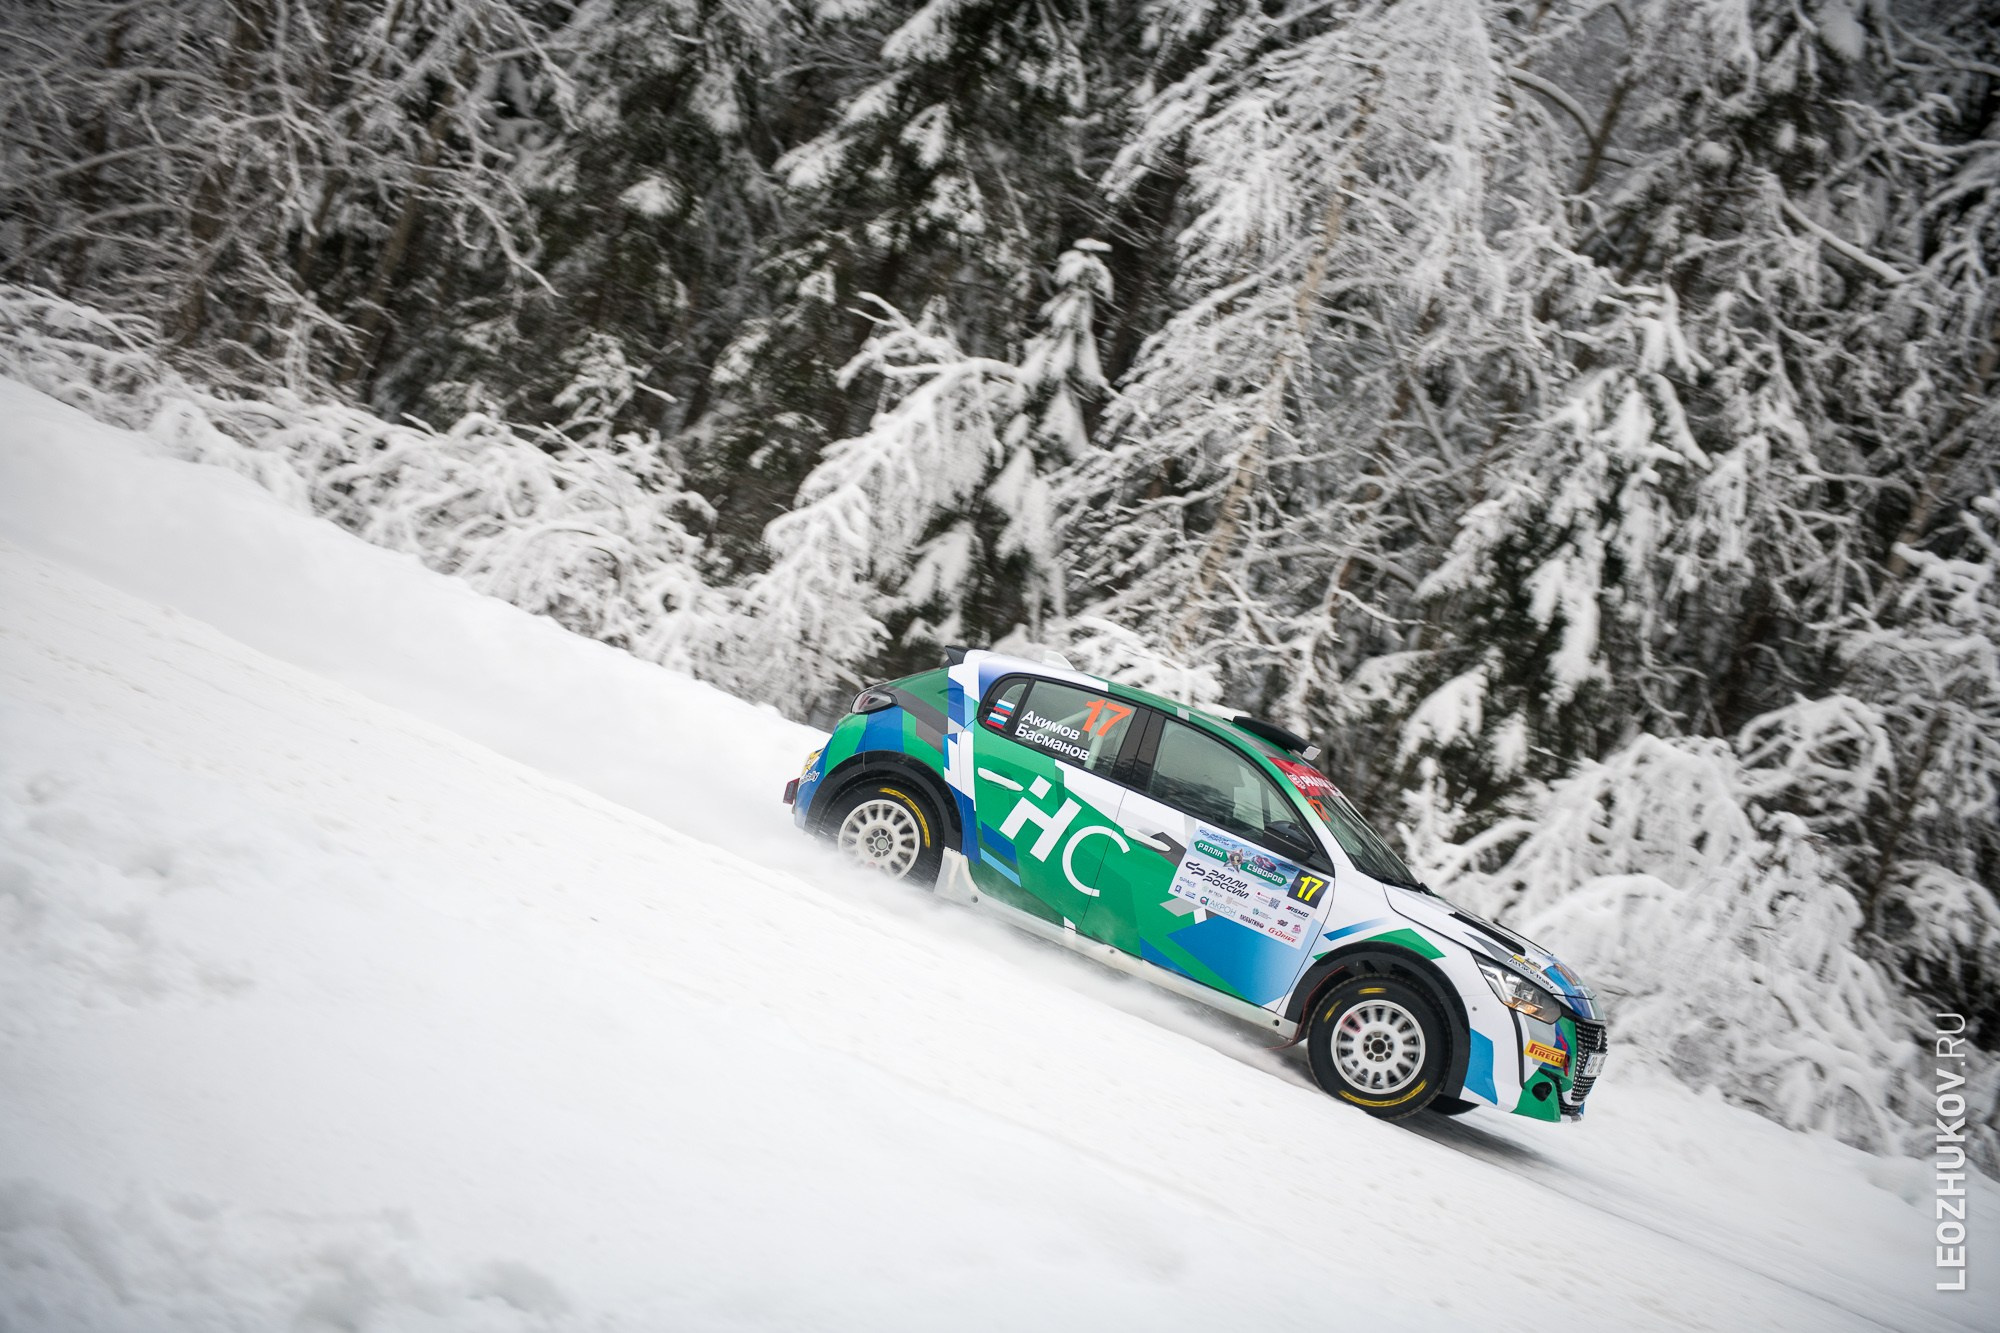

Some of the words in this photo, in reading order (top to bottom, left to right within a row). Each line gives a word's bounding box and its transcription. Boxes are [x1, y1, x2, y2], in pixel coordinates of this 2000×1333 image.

[1021, 710, 1081, 741] Акимов
[1082, 699, 1132, 737] 17
[1014, 723, 1090, 761] Басманов
[1197, 842, 1224, 858] РАЛЛИ
[1246, 863, 1284, 884] СУВОРОВ
[1202, 875, 1250, 899] РОССИИ
[1208, 869, 1248, 890] РАЛЛИ
[1297, 875, 1324, 902] 17
[1209, 899, 1237, 917] АКРОН
[1529, 1043, 1566, 1064] PIRELLI
